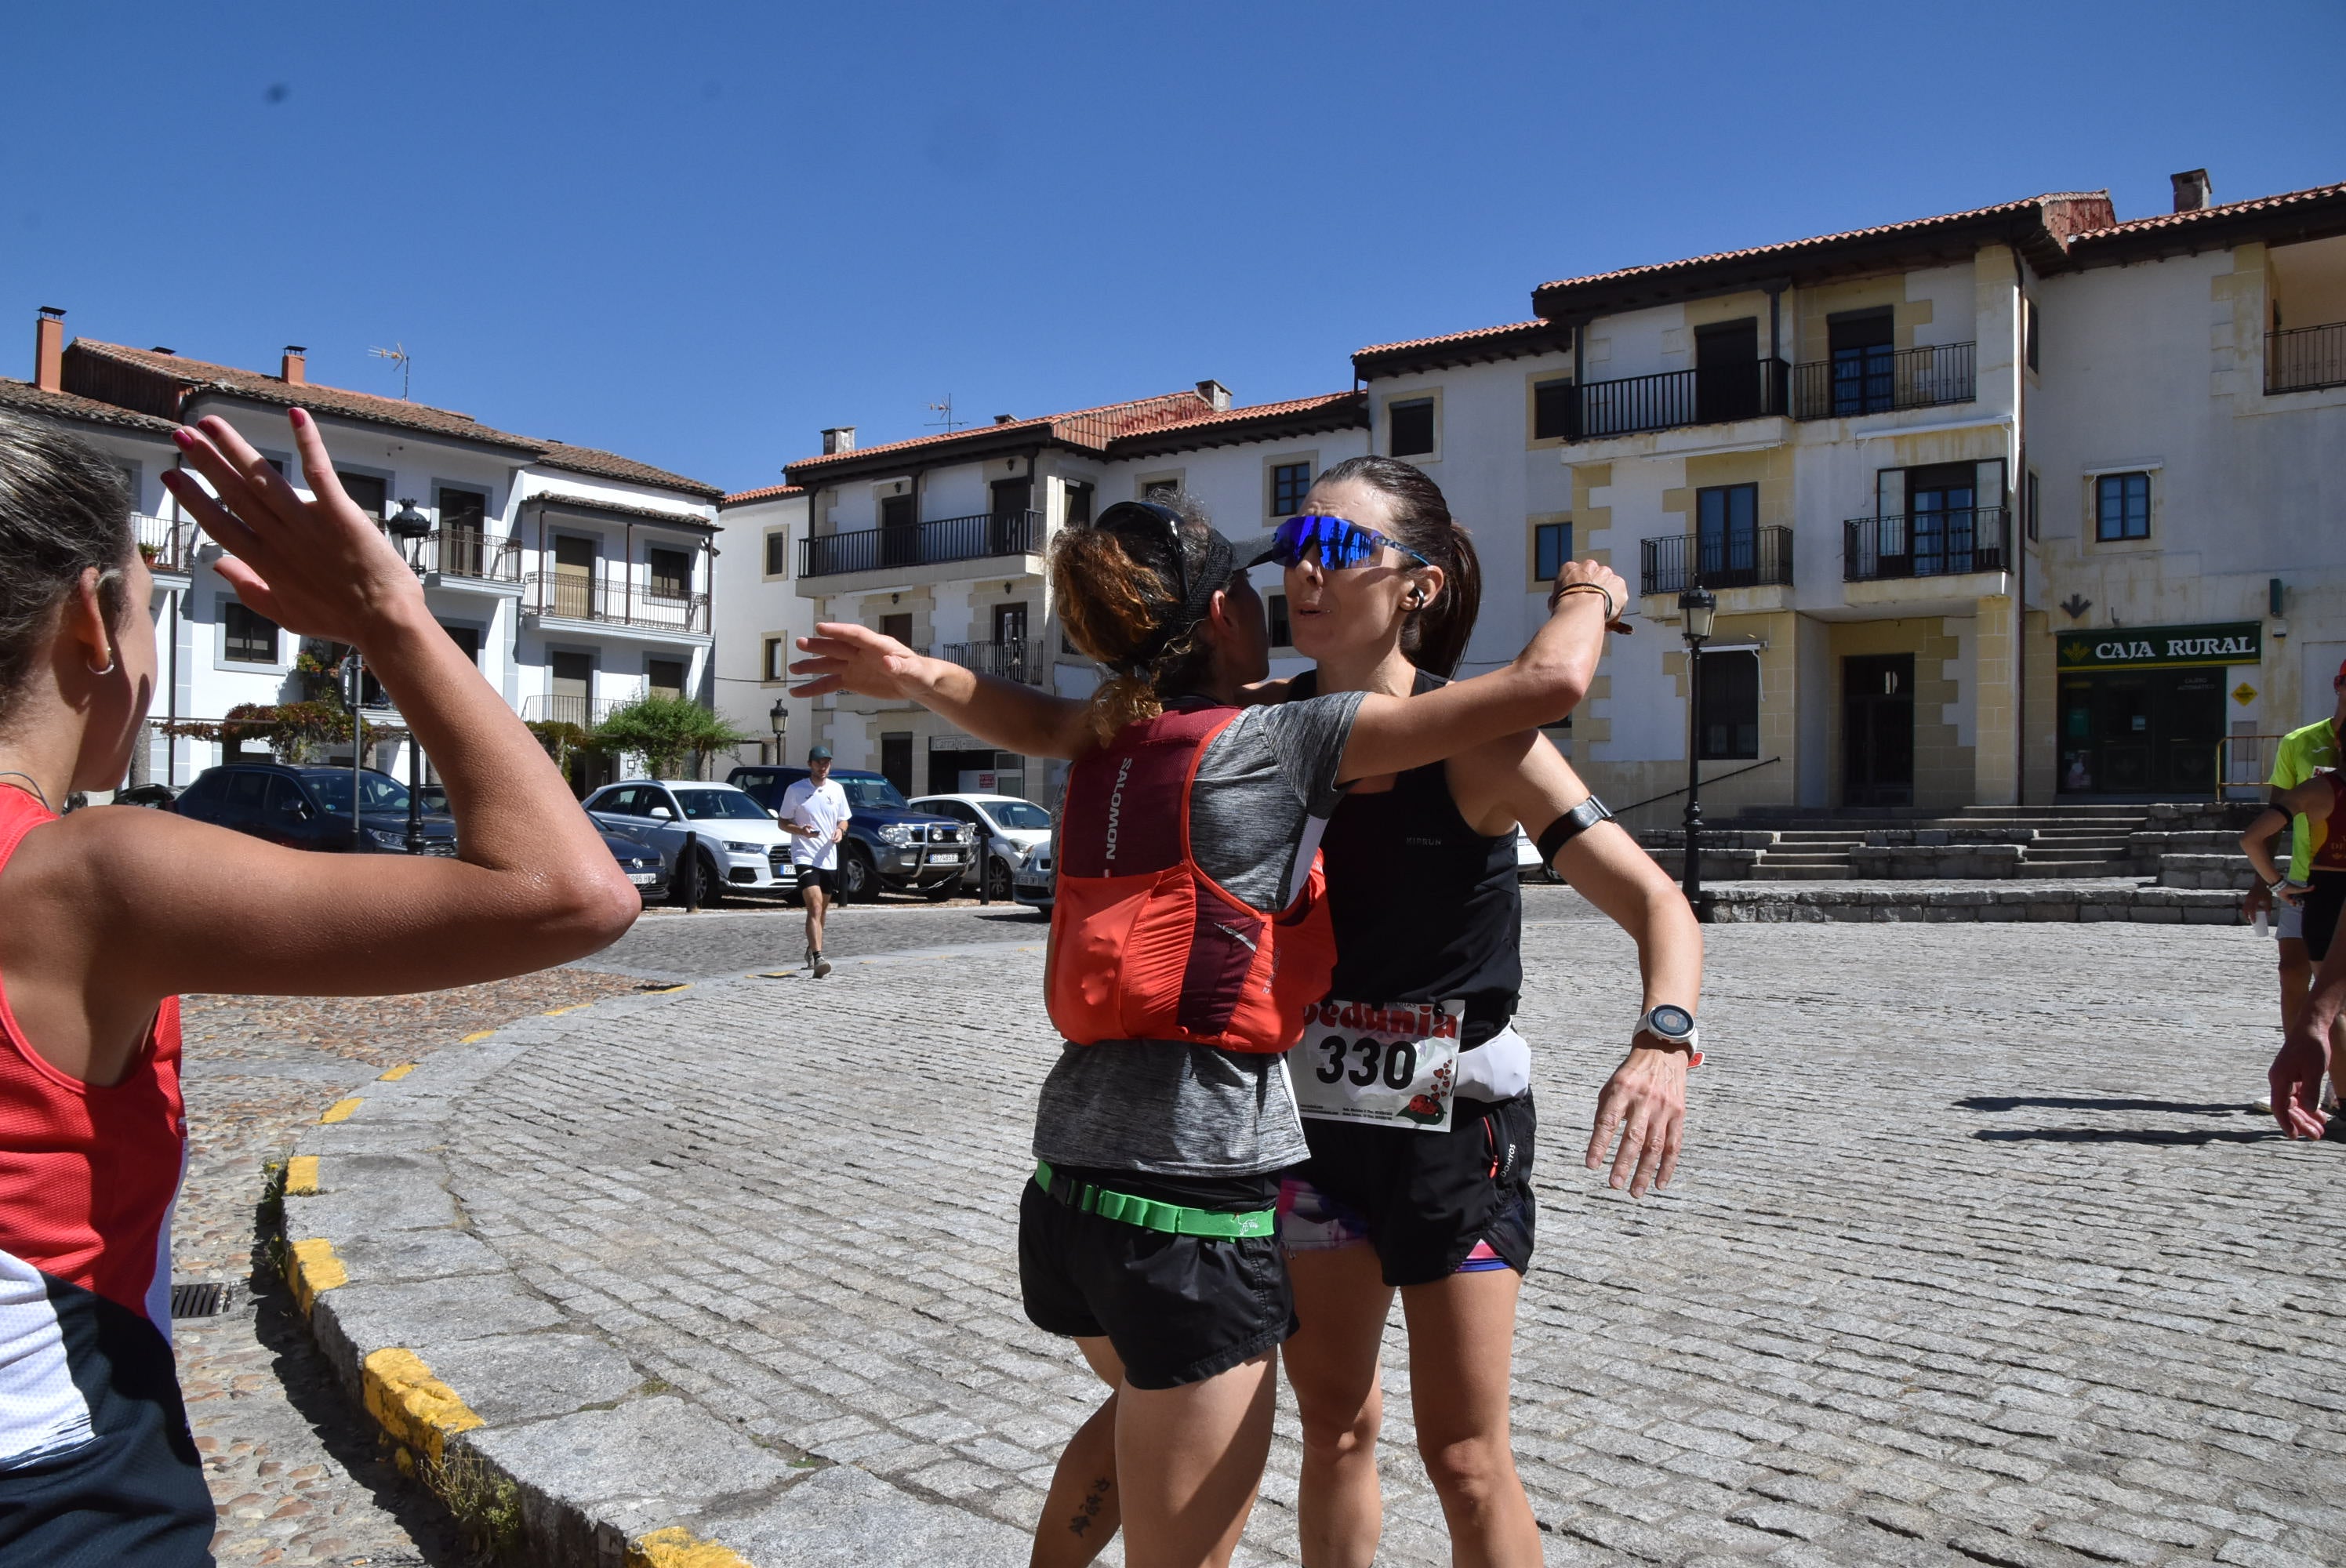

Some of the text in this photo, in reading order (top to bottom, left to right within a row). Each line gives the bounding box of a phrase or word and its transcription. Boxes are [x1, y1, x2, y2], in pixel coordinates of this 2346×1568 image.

[2096, 637, 2256, 659] CAJA RURAL
[1106, 757, 1132, 860] SALOMON
[1316, 1036, 1418, 1091] 330
[1500, 1144, 1516, 1178] DOMYOS
